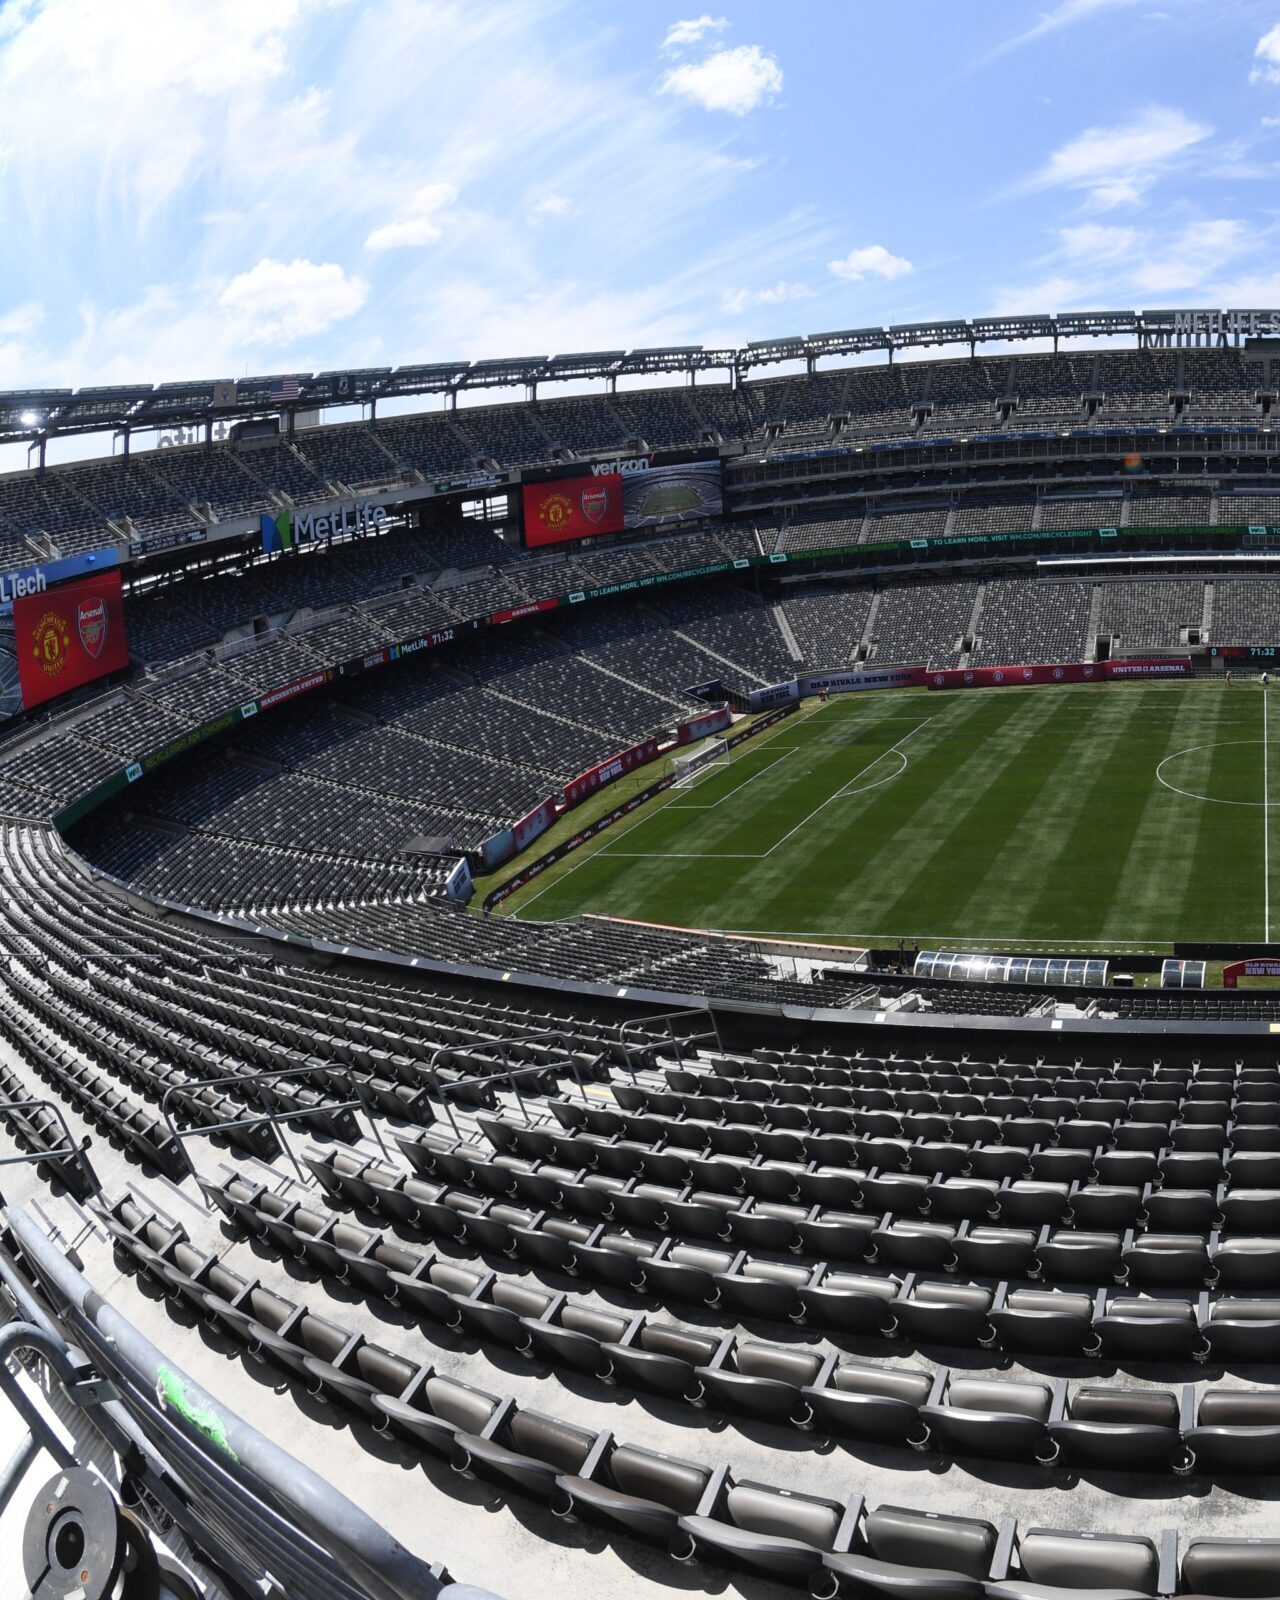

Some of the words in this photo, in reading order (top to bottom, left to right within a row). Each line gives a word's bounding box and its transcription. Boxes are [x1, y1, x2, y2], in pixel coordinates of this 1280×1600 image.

[1174, 312, 1262, 334] METLIFE
[591, 458, 650, 476] verizon
[294, 502, 387, 545] MetLife
[80, 603, 104, 621] Arsenal
[432, 629, 454, 645] 71:32
[401, 638, 428, 654] MetLife
[1211, 648, 1217, 656] 0
[1250, 647, 1275, 656] 71:32
[1113, 665, 1142, 673] UNITED
[811, 680, 829, 689] OLD
[864, 675, 888, 683] NEW
[1245, 967, 1265, 975] NEW
